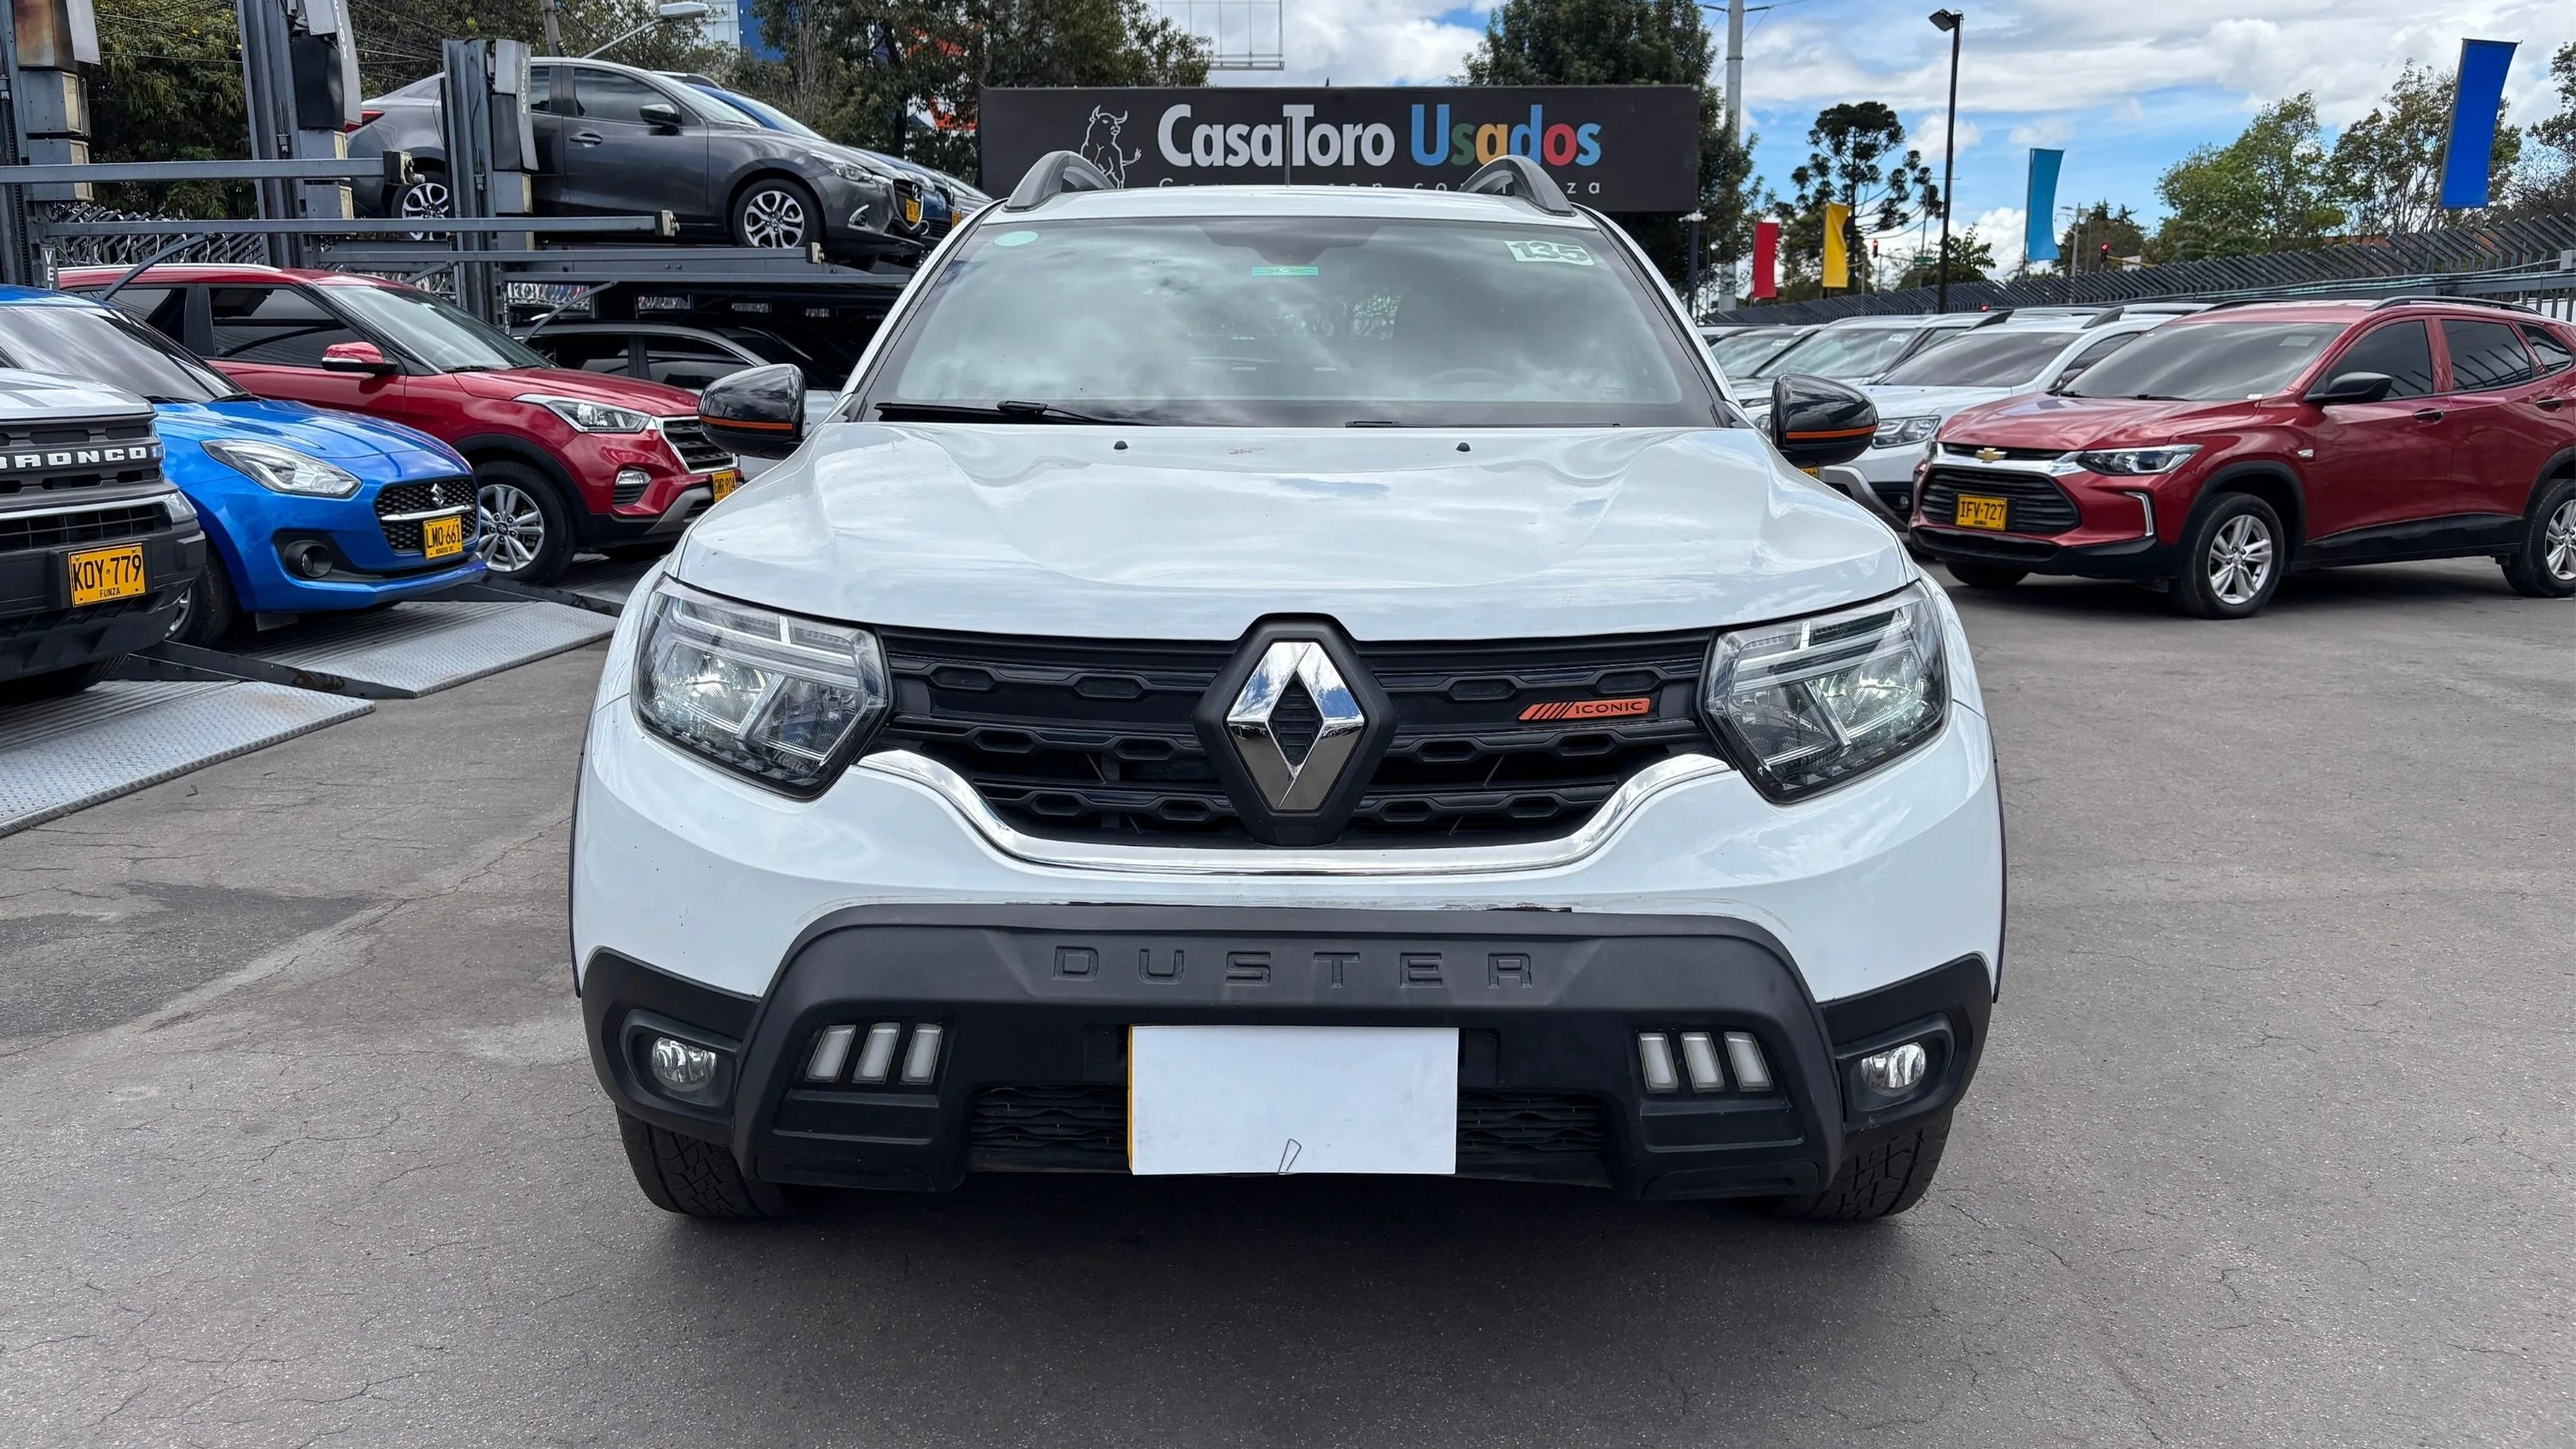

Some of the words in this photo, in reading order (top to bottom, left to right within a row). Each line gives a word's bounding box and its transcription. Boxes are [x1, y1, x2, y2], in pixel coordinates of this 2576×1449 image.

[1157, 103, 1395, 167] CasaToro
[1411, 104, 1601, 167] Usados
[1511, 241, 1589, 261] 135
[100, 587, 120, 598] FUNZA
[1575, 702, 1643, 715] ICONIC
[1053, 946, 1532, 989] DUSTER
